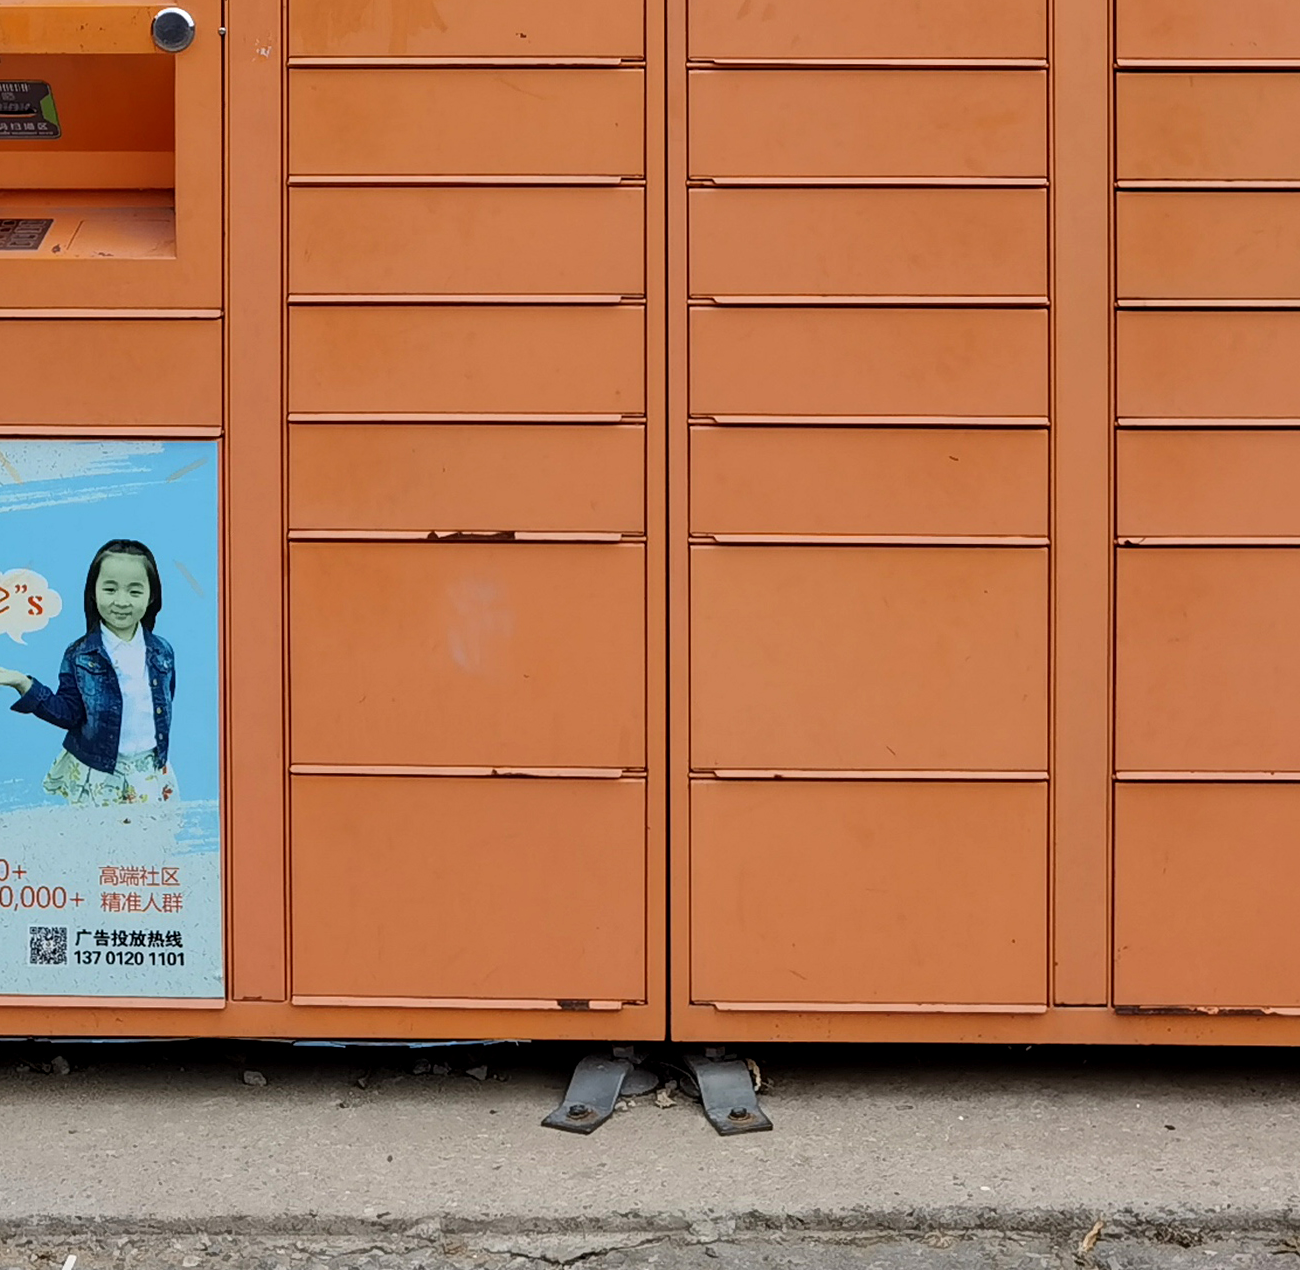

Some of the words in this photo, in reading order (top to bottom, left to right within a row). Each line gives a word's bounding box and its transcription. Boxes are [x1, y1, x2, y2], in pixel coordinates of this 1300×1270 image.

[99, 865, 181, 887] 高端社区
[99, 891, 184, 914] 精准人群
[74, 929, 183, 949] 广告投放热线
[74, 950, 102, 966] 137
[104, 951, 145, 966] 0120
[149, 951, 185, 967] 1101
